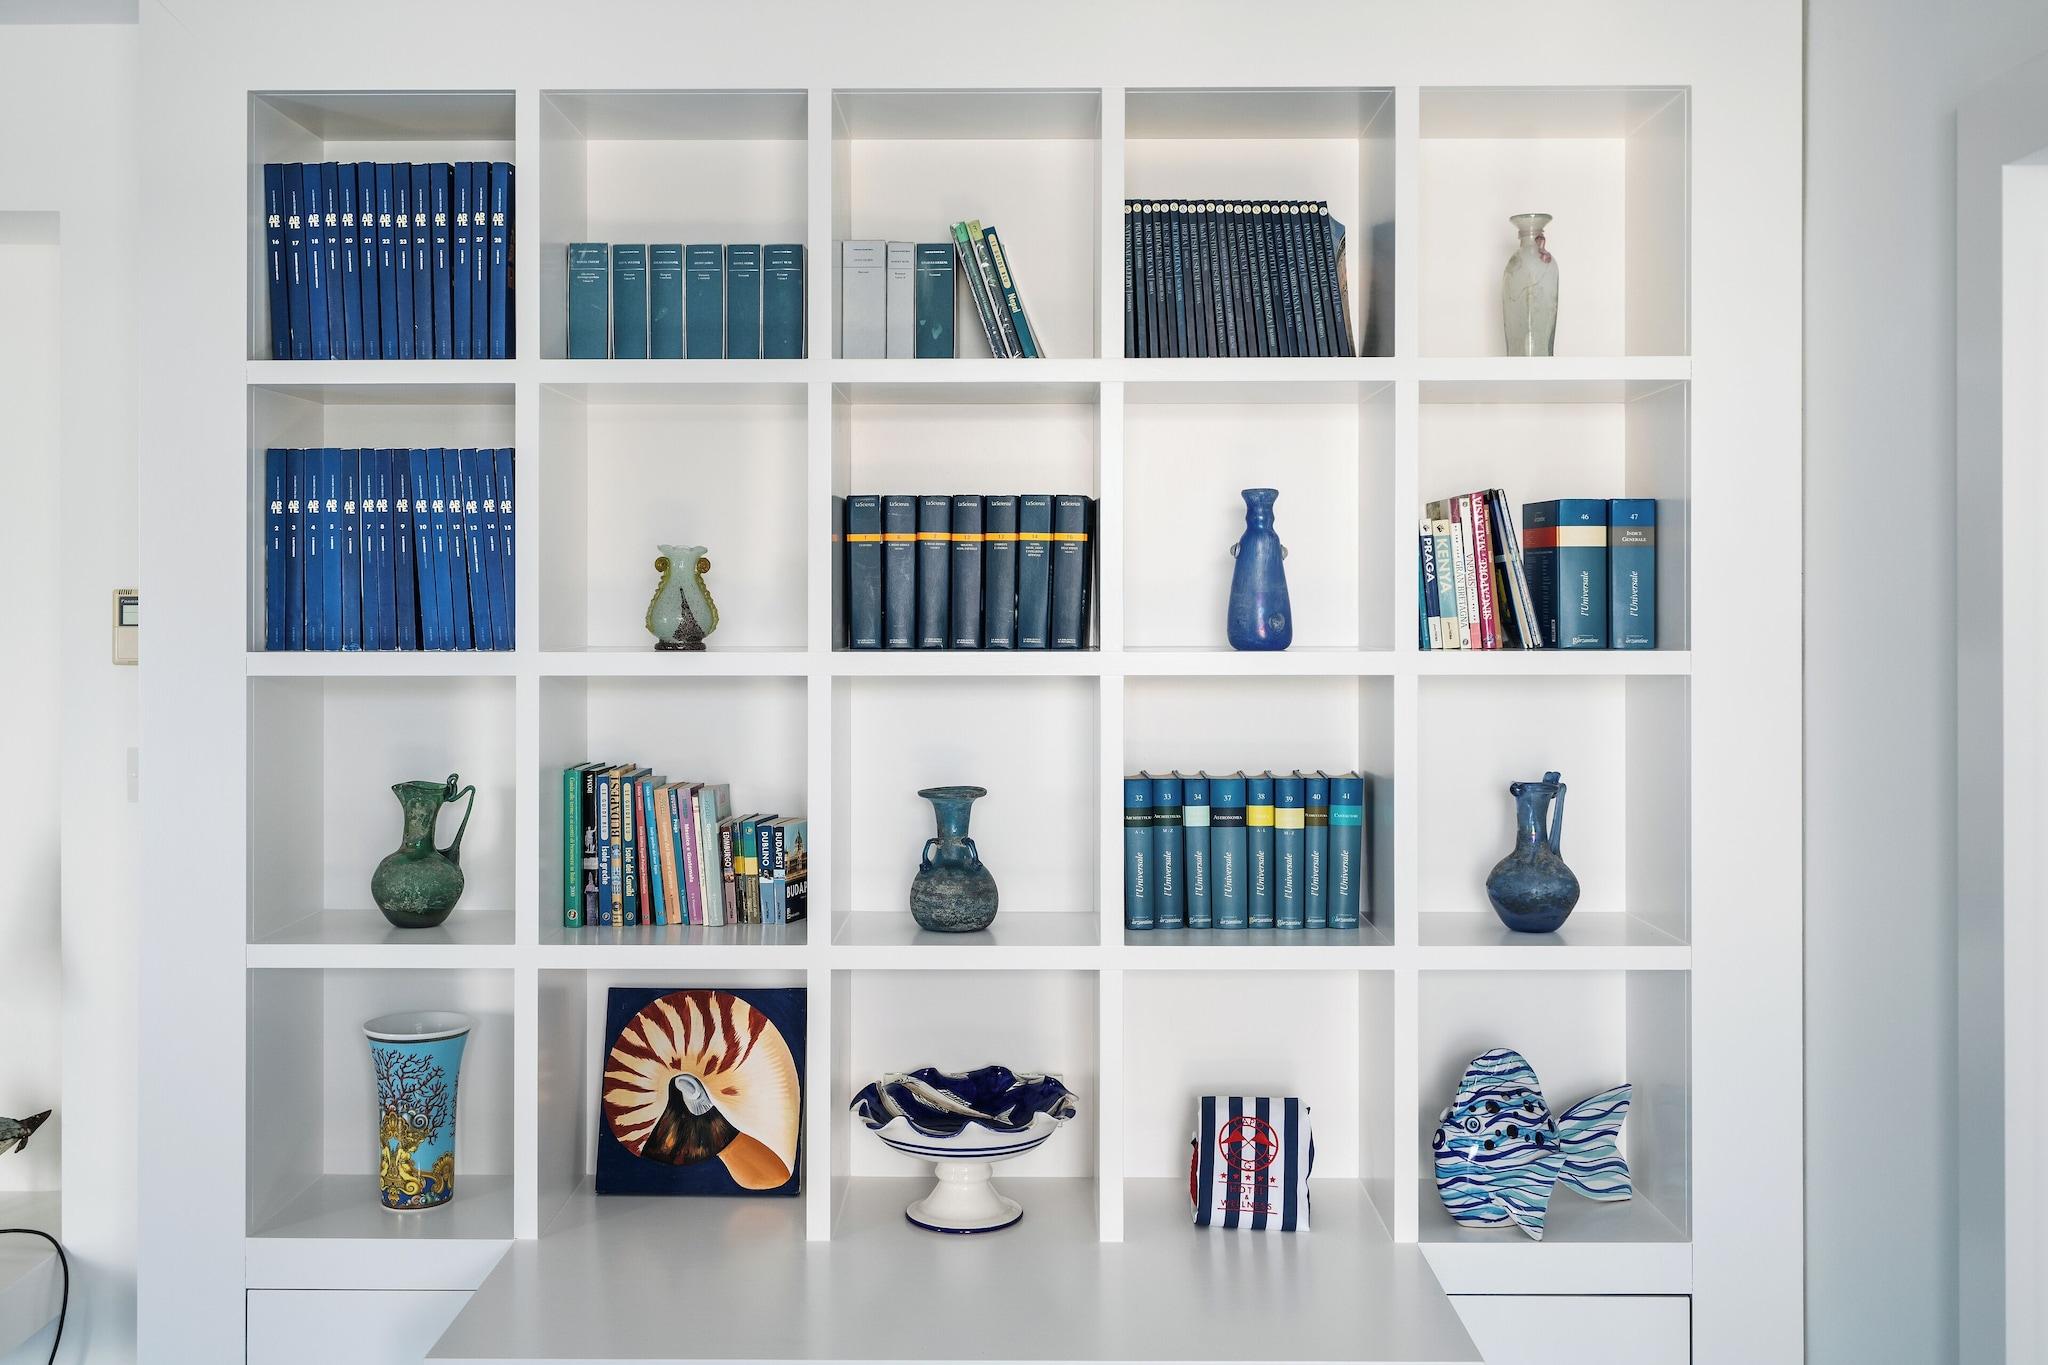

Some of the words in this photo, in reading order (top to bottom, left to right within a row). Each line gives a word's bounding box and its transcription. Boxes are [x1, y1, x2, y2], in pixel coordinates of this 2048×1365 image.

[1173, 222, 1181, 272] METROPOLITAN
[1228, 222, 1238, 272] MUSEUMSINSEL
[1237, 224, 1248, 270] RIJKSMUSEUM
[1246, 223, 1256, 254] GALLERIA
[1256, 225, 1264, 247] MUSEO
[1265, 223, 1274, 252] PALAZZO
[1250, 257, 1259, 291] BORGHESE
[1280, 258, 1290, 306] CAPODIMONTE
[1284, 223, 1294, 264] PINACOTECA
[1289, 266, 1299, 309] AMBROSIANA
[1304, 223, 1314, 264] PINACOTECA
[1313, 291, 1321, 315] ANTICA
[1316, 244, 1326, 282] CAPITOLINI
[1008, 292, 1021, 313] Nepal
[1329, 272, 1338, 299] PEZZOLI
[1473, 496, 1487, 551] MALAYSIA
[1424, 538, 1435, 583] PRAGA
[1436, 538, 1452, 593] KENYA
[1456, 560, 1464, 586] GRAN
[1466, 554, 1475, 587] SPAGNA
[1458, 586, 1467, 628] BRETAGNA
[1479, 558, 1492, 620] SINGAPORE
[1630, 571, 1638, 616] l'Universale
[610, 776, 620, 838] BUDAPEST
[625, 848, 633, 862] Isole
[626, 864, 634, 874] dei
[686, 852, 694, 882] Guatemala
[723, 832, 732, 867] EDIMBURGO
[761, 832, 770, 866] DUBLINO
[601, 863, 610, 885] greche
[626, 875, 634, 896] Caraibi
[1135, 852, 1144, 898] l'Universale
[1164, 850, 1172, 896] l'Universale
[1194, 850, 1203, 896] l'Universale
[1224, 852, 1232, 897] l'Universale
[1284, 852, 1292, 899] l'Universale
[1311, 850, 1319, 896] l'Universale
[1340, 850, 1349, 895] l'Universale
[1220, 1199, 1272, 1210] WELLNESS
[1230, 1185, 1264, 1195] HOTEL
